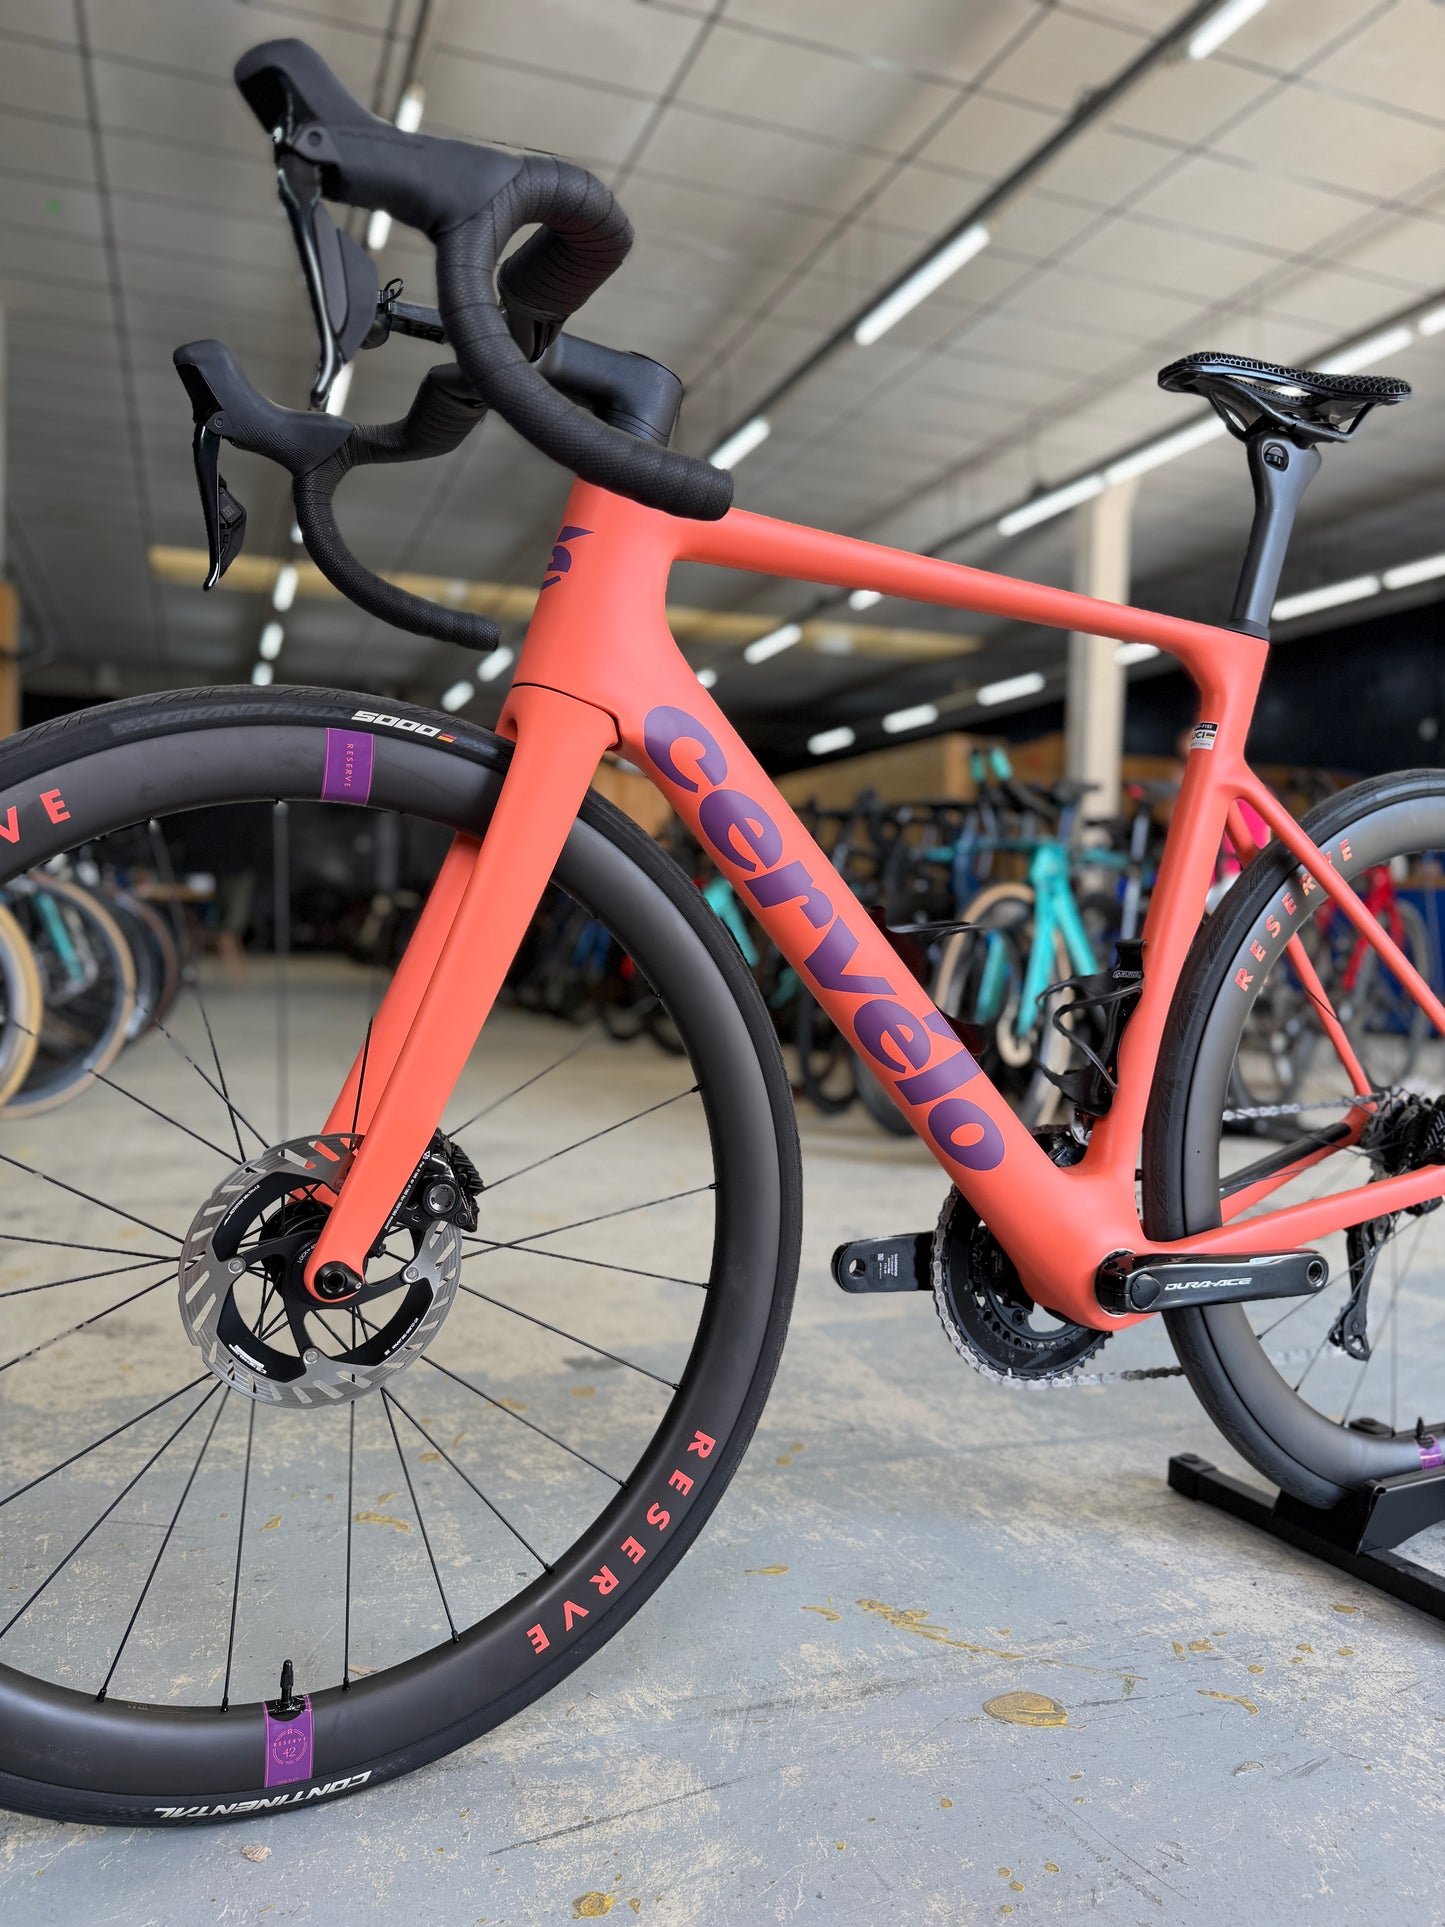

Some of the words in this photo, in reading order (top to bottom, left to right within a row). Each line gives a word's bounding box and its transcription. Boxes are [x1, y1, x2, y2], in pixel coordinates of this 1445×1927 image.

[351, 709, 442, 738] 5000
[343, 743, 354, 788] RESERVE
[643, 705, 1006, 1171] cervélo
[1164, 1277, 1253, 1291] DURA-ACE
[526, 1430, 717, 1655] RESERVE
[282, 1746, 296, 1758] 42
[153, 1770, 373, 1819] CONTINENTAL
